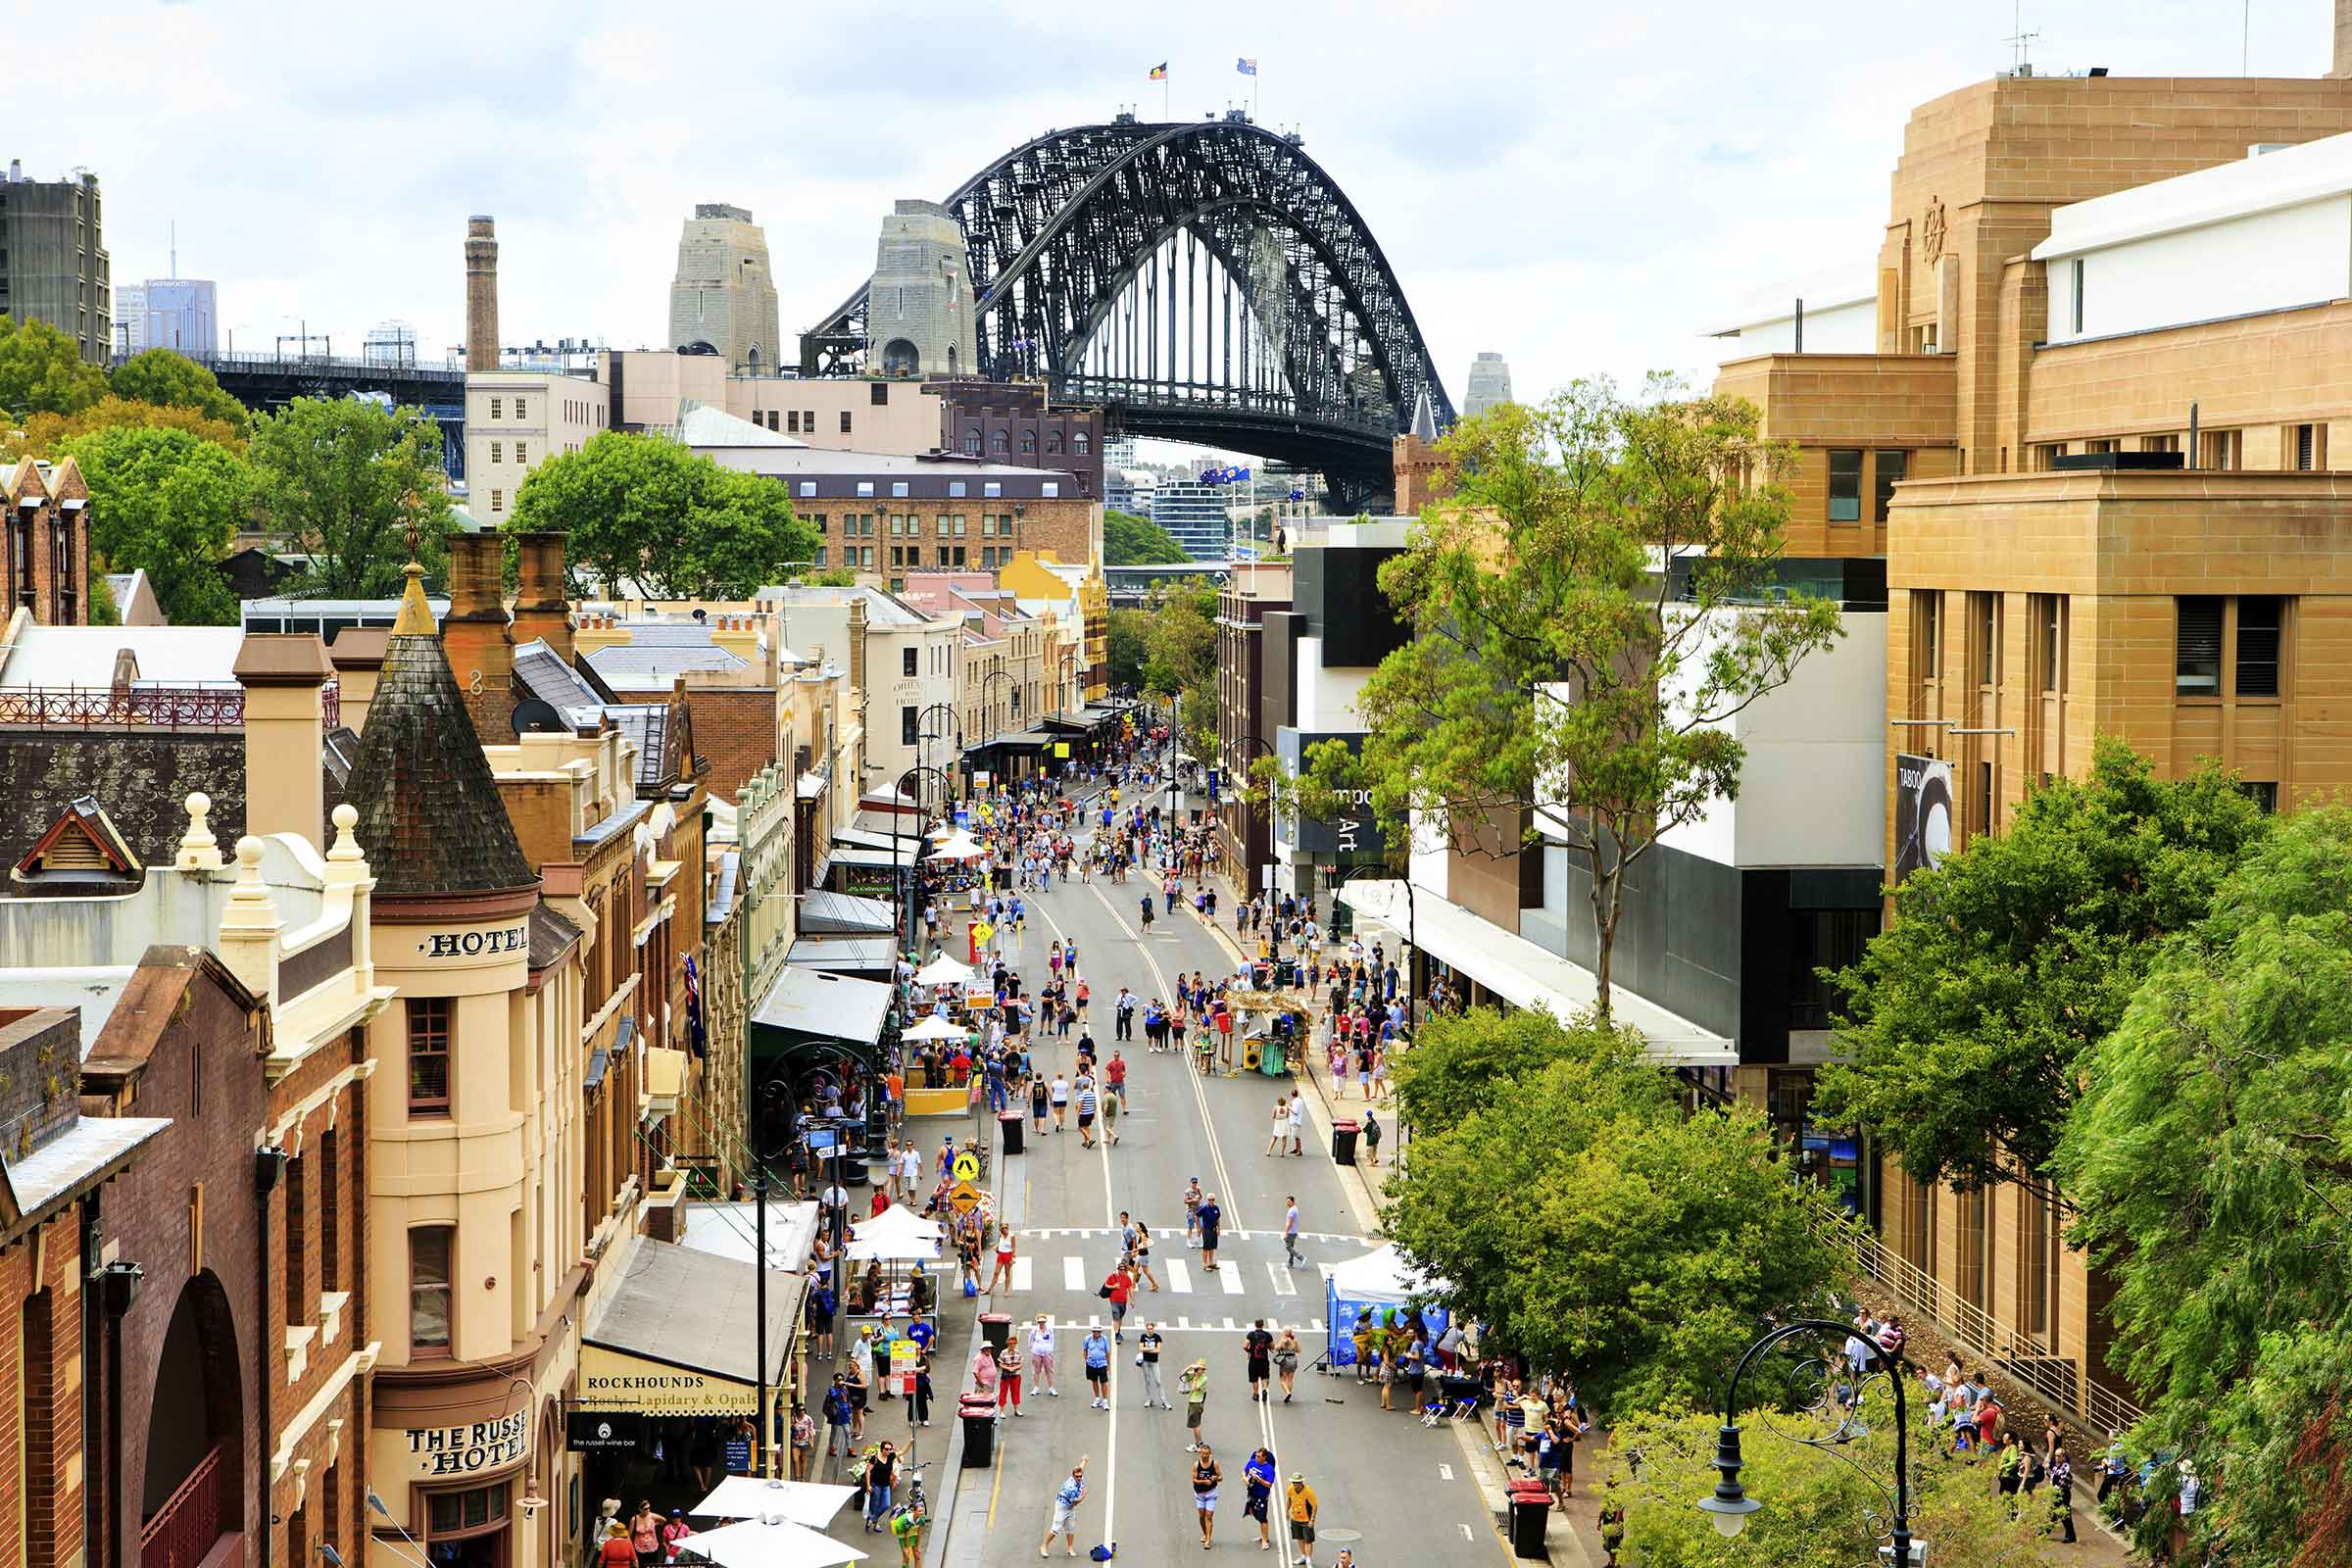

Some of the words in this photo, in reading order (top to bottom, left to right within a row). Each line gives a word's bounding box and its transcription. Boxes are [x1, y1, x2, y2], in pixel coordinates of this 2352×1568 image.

[1899, 767, 1922, 790] TABOO
[1338, 816, 1360, 853] Art
[428, 926, 528, 957] HOTEL
[588, 1376, 705, 1389] ROCKHOUNDS
[637, 1394, 699, 1408] Lapidary
[704, 1395, 714, 1405] &
[719, 1393, 757, 1407] Opals
[406, 1428, 465, 1453] THE
[469, 1409, 527, 1448] RUSSE
[430, 1432, 527, 1476] HOTEL
